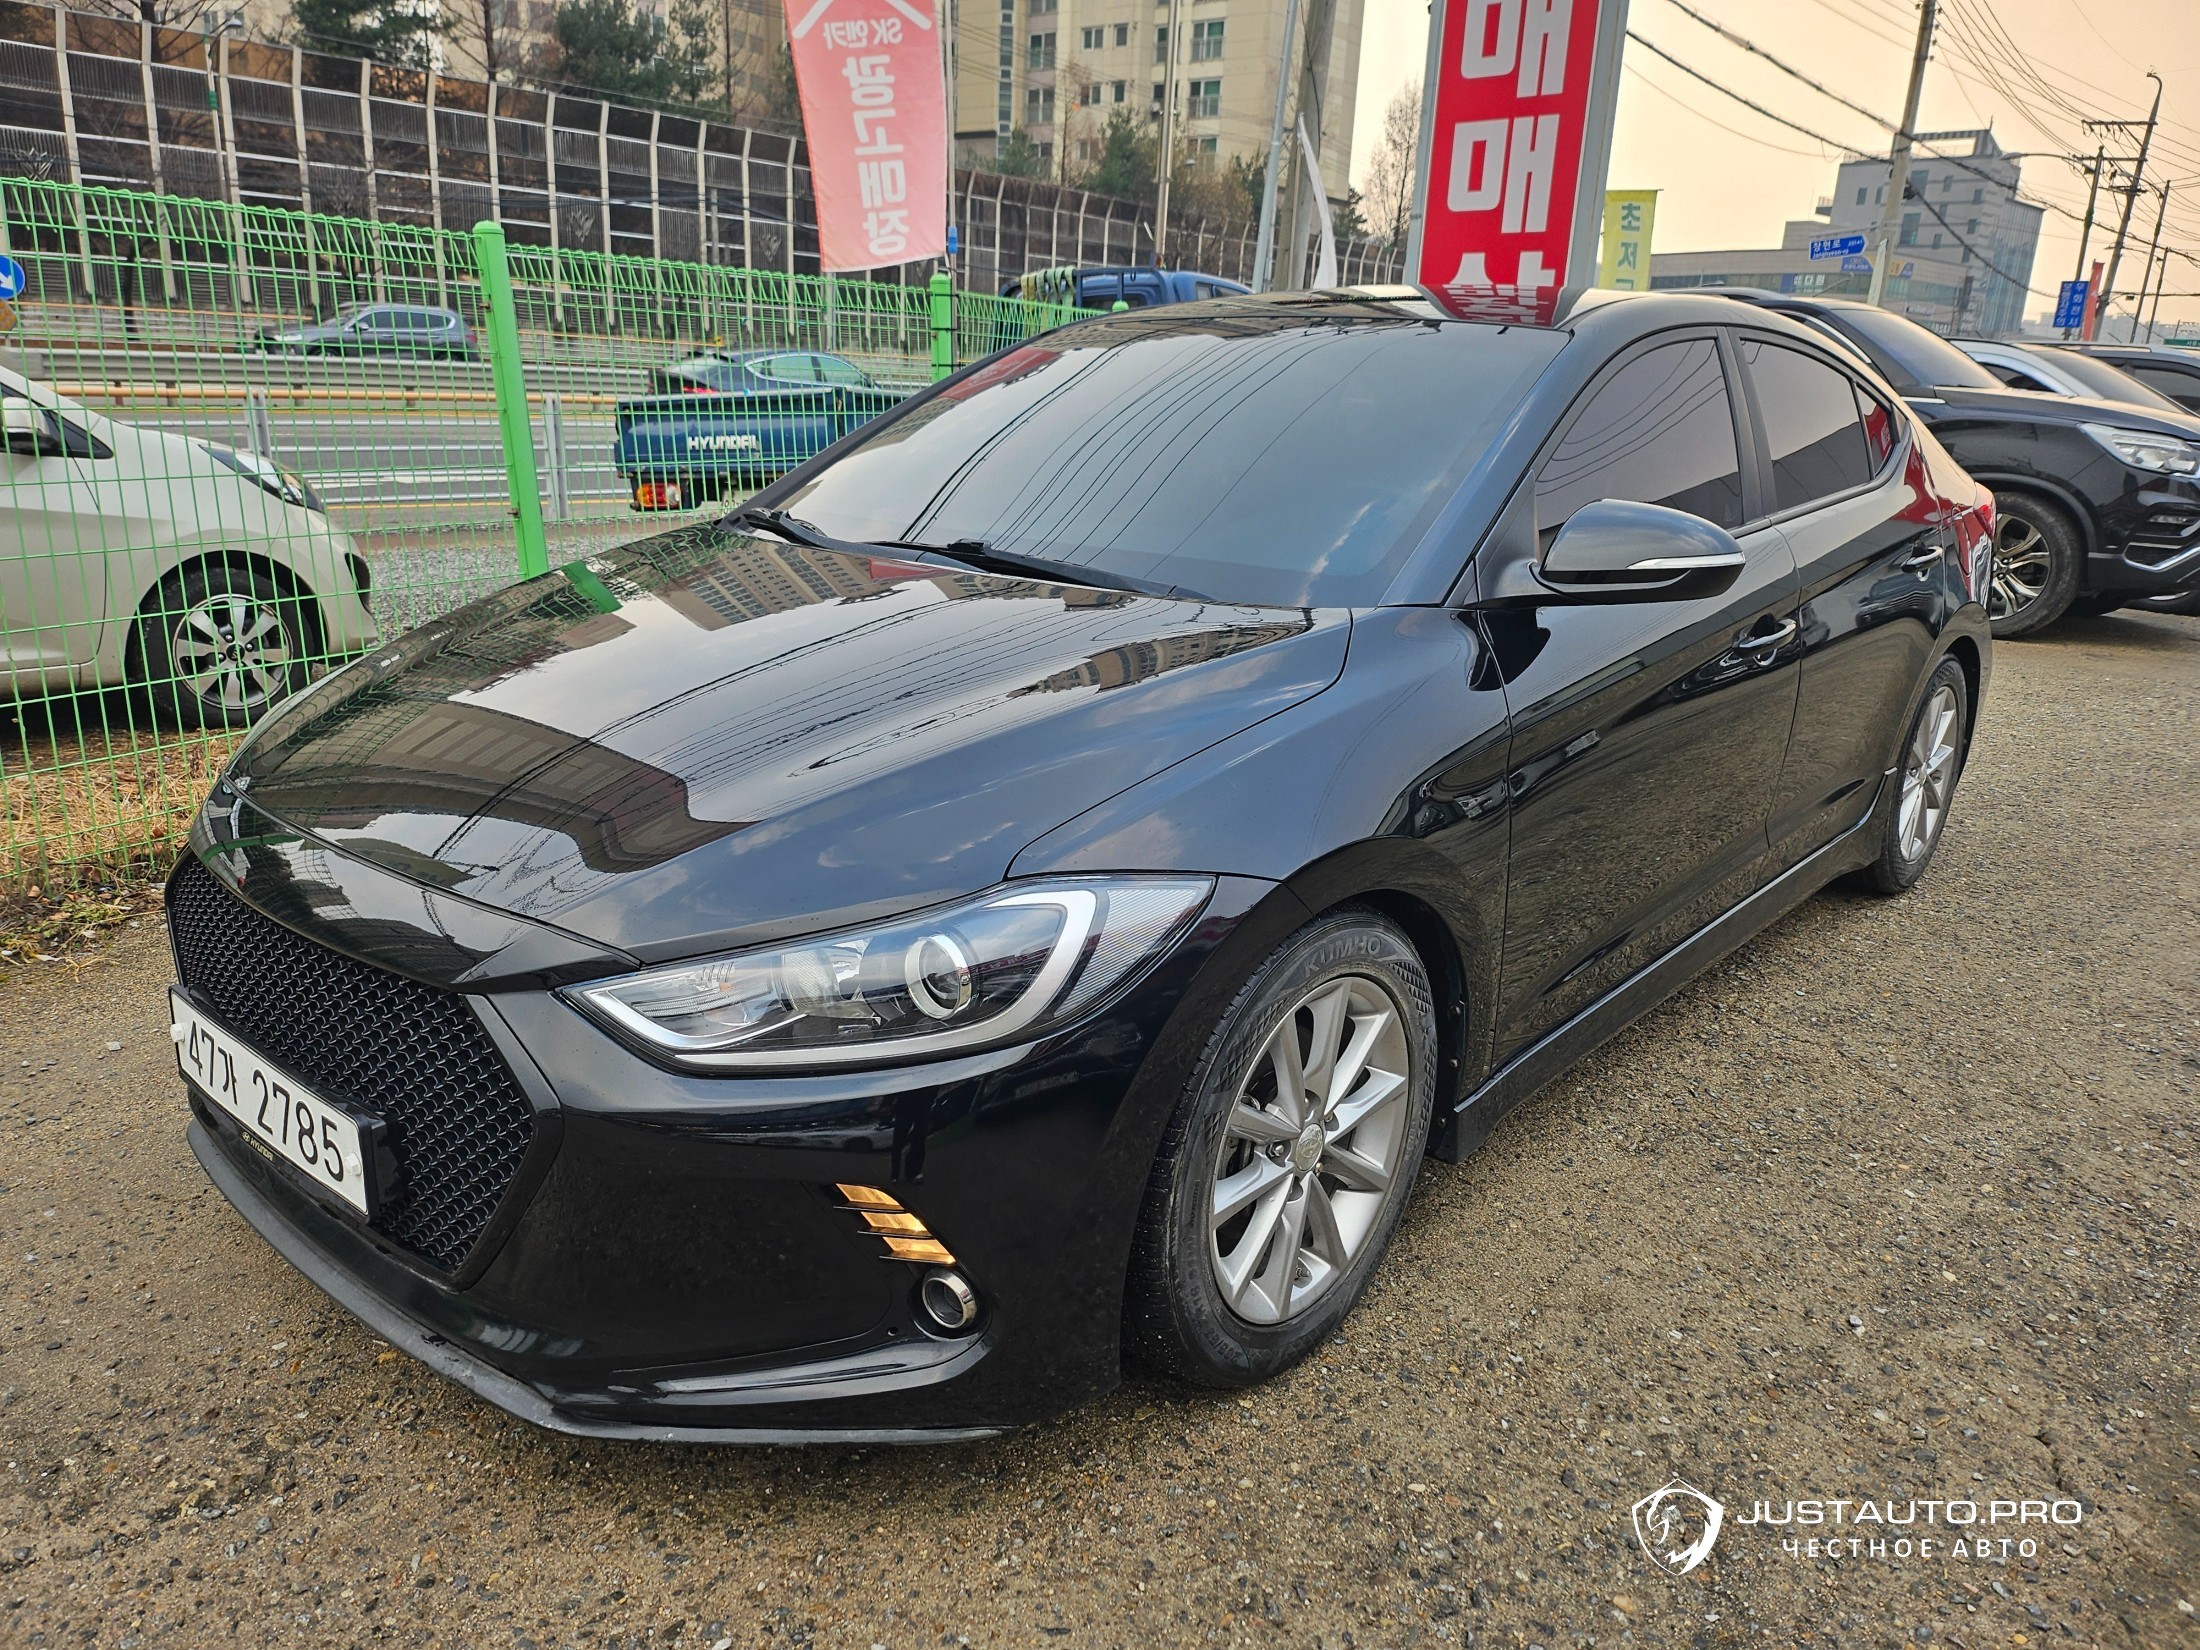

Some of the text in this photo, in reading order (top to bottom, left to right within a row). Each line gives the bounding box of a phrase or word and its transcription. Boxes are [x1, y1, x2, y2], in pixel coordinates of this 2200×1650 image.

[687, 434, 757, 450] HYUNDAI
[1303, 935, 1382, 979] KUMHO
[188, 1019, 345, 1183] 47가 2785
